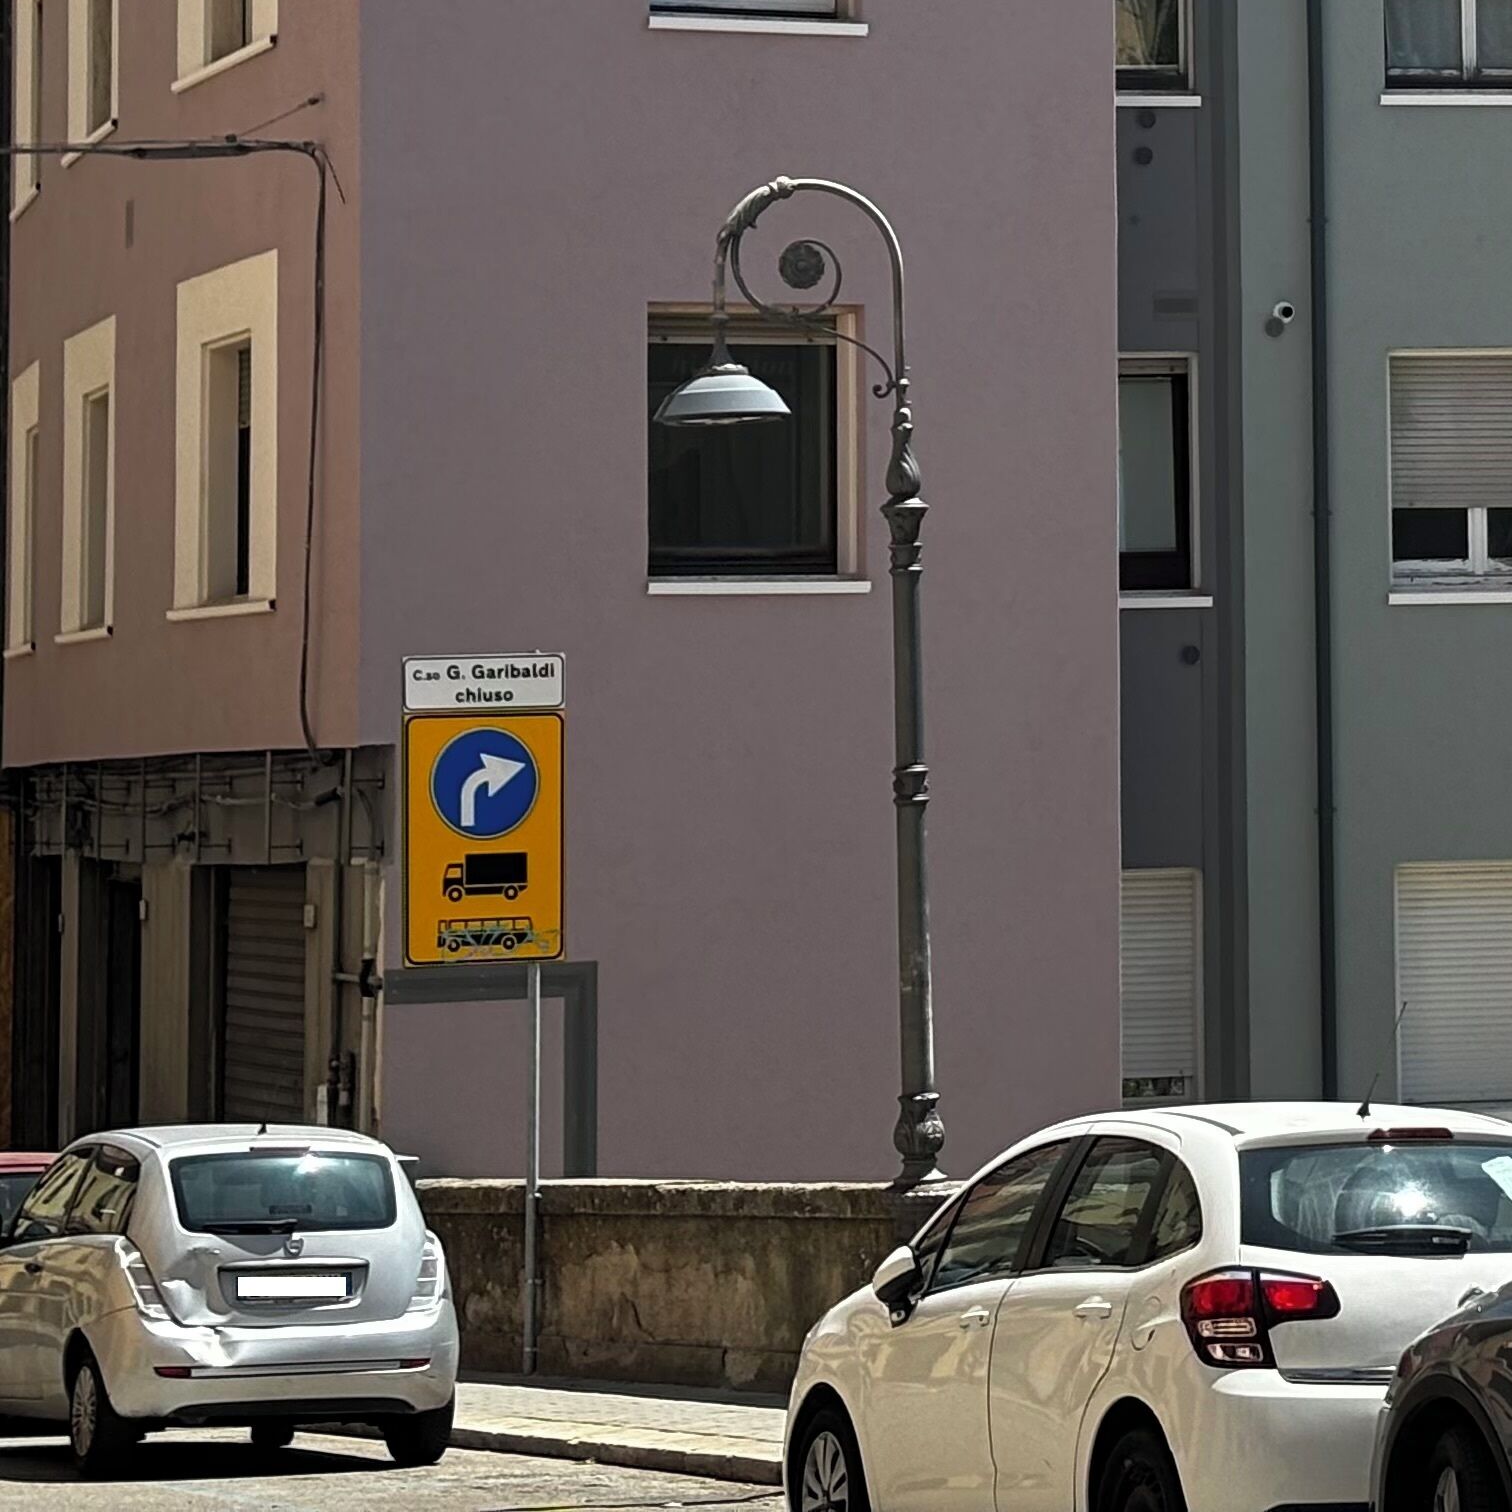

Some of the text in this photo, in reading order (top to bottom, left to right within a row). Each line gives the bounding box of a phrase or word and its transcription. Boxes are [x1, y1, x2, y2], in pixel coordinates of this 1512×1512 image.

[446, 665, 466, 680] G.
[471, 663, 555, 680] Garibaldi
[455, 688, 514, 704] chiuso
